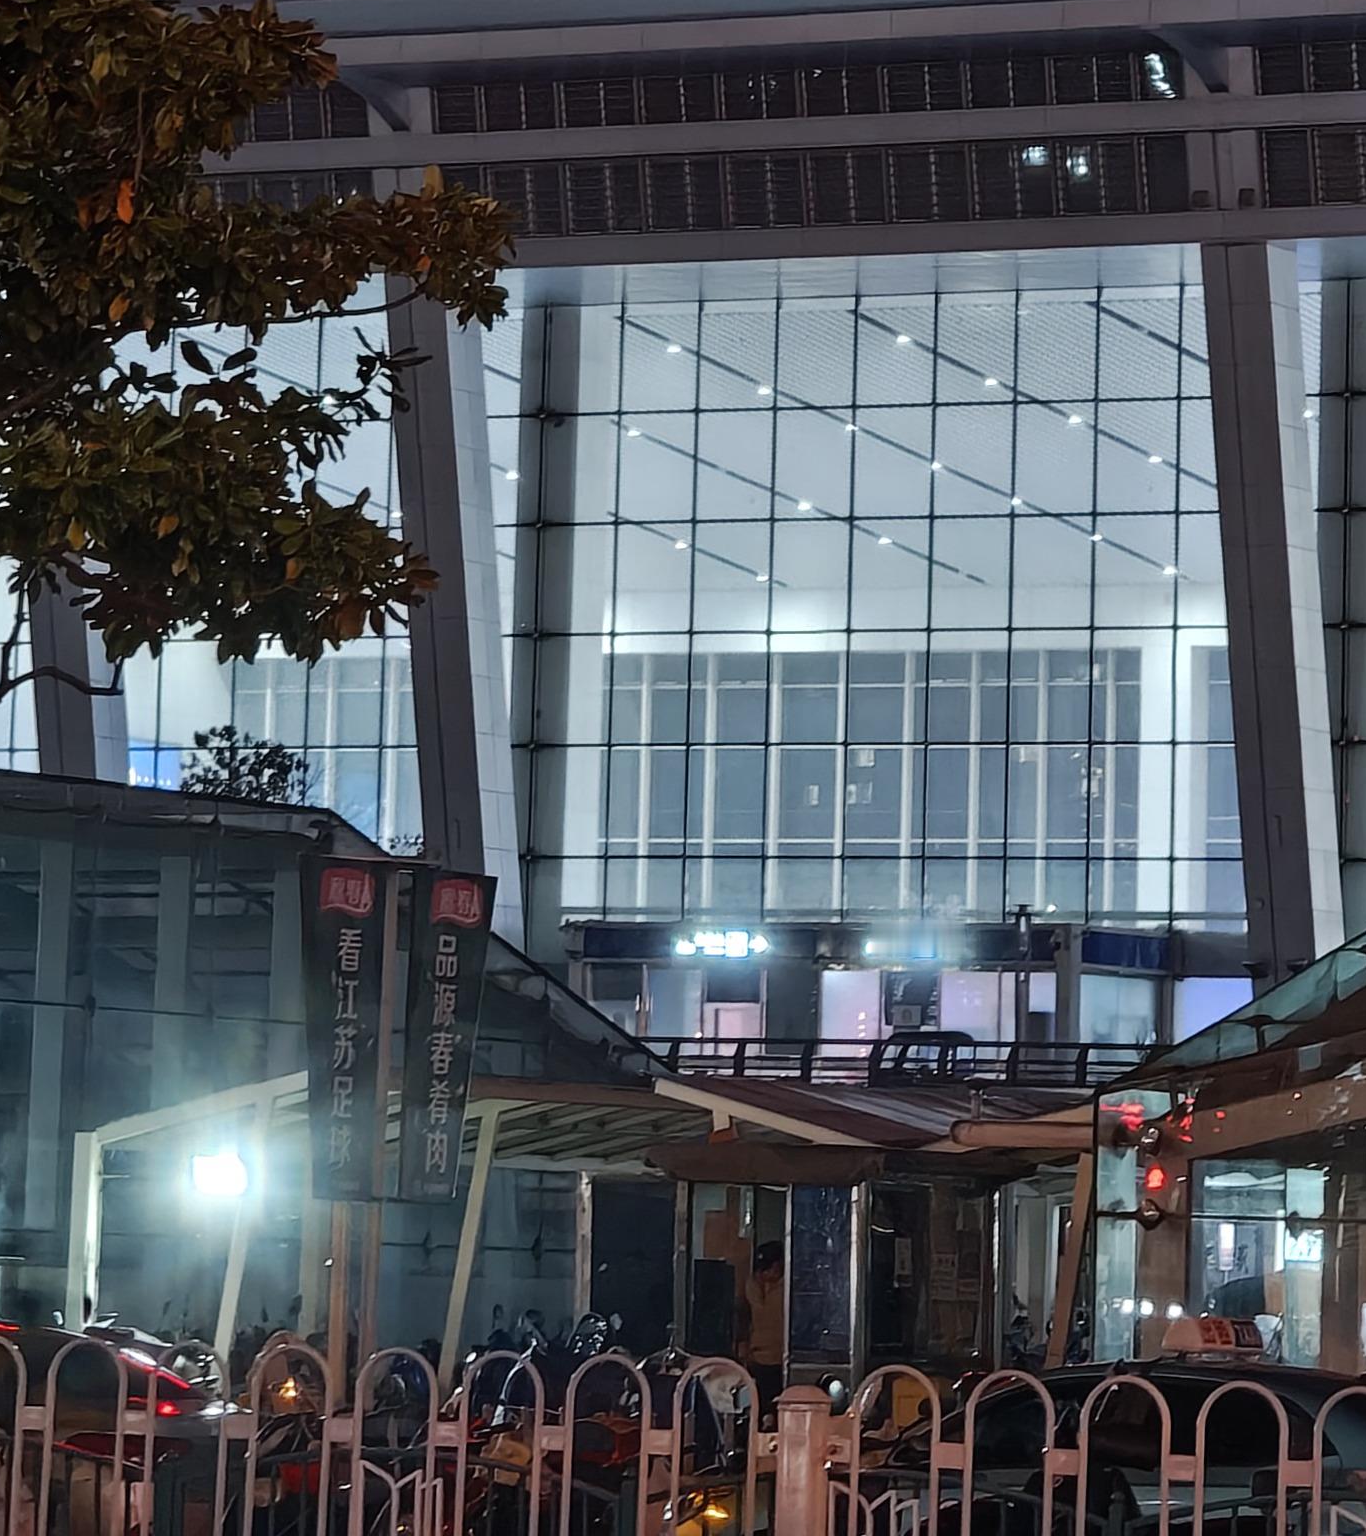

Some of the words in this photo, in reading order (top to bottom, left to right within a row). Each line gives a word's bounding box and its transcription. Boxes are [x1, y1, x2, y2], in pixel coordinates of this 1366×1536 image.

[329, 927, 363, 1170] 看江苏足球
[424, 934, 460, 1175] 品源春肴肉
